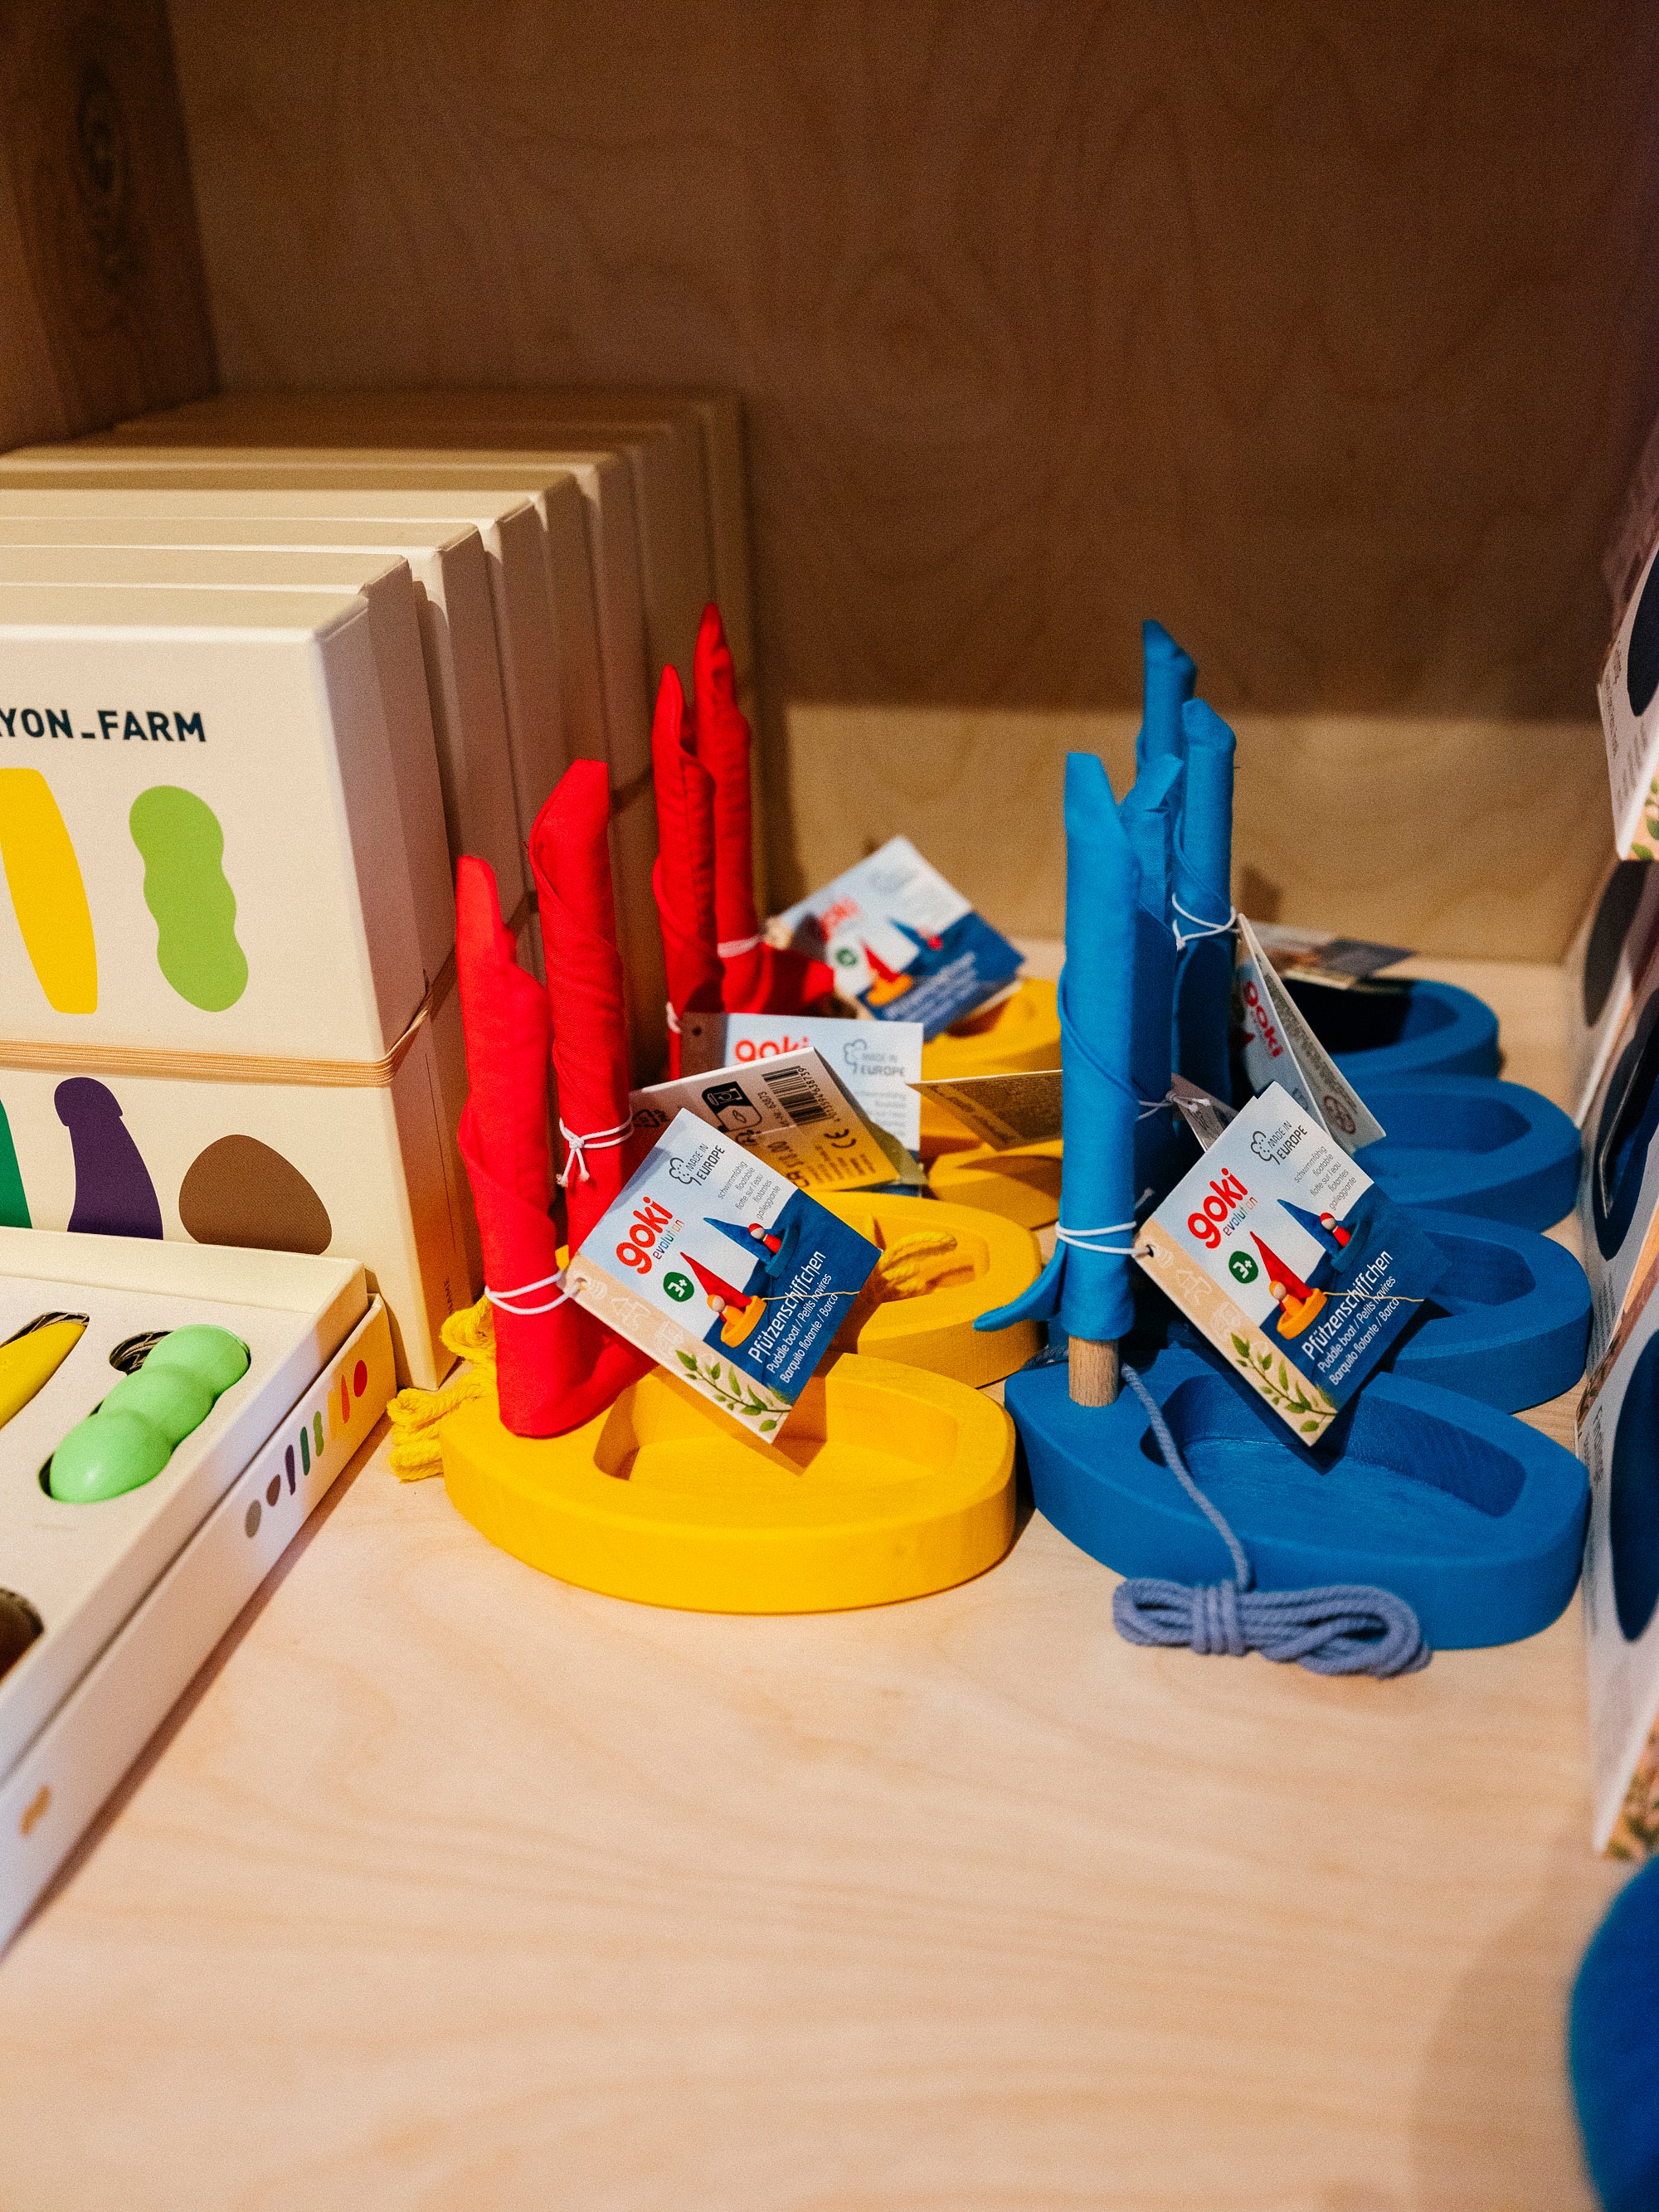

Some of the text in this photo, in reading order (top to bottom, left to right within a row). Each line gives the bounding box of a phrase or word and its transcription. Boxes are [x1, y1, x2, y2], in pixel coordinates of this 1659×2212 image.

[0, 707, 206, 742] YON_FARM
[1267, 1120, 1292, 1149] MADE IN
[1277, 1125, 1308, 1159] EUROPE
[685, 1143, 709, 1171] MADE IN
[697, 1145, 726, 1180] EUROPE
[1294, 1146, 1328, 1184] schwimmfähig
[1313, 1154, 1334, 1177] floatable
[718, 1160, 748, 1199] schwimmfähig
[735, 1166, 756, 1191] floatable
[747, 1184, 757, 1197] sur
[752, 1179, 772, 1203] flotantes
[1322, 1173, 1332, 1185] sur
[1327, 1169, 1349, 1193] flotantes
[1329, 1176, 1357, 1211] galleggiante
[756, 1185, 781, 1221] galleggiante
[1188, 1168, 1248, 1249] goki
[1223, 1196, 1258, 1237] evoluton
[616, 1196, 674, 1275] goki
[652, 1219, 685, 1260] evoluton
[1232, 1260, 1253, 1280] 3+
[667, 1279, 688, 1298] 3+
[1301, 1250, 1394, 1361] Pfützenschiffchen
[748, 1250, 826, 1364] Pfützenschiffchen
[766, 1343, 790, 1373] Puddle
[783, 1325, 800, 1349] boat
[797, 1300, 816, 1324] Petits
[811, 1273, 832, 1301] navires
[1317, 1343, 1344, 1373] Puddle
[1337, 1324, 1357, 1347] boat
[1355, 1300, 1376, 1325] Petits
[1372, 1276, 1396, 1305] navires
[779, 1349, 805, 1384] Barquito
[798, 1321, 823, 1351] flotante
[819, 1293, 839, 1317] Barca
[1329, 1349, 1359, 1386] Barquito
[1353, 1322, 1379, 1353] flotante
